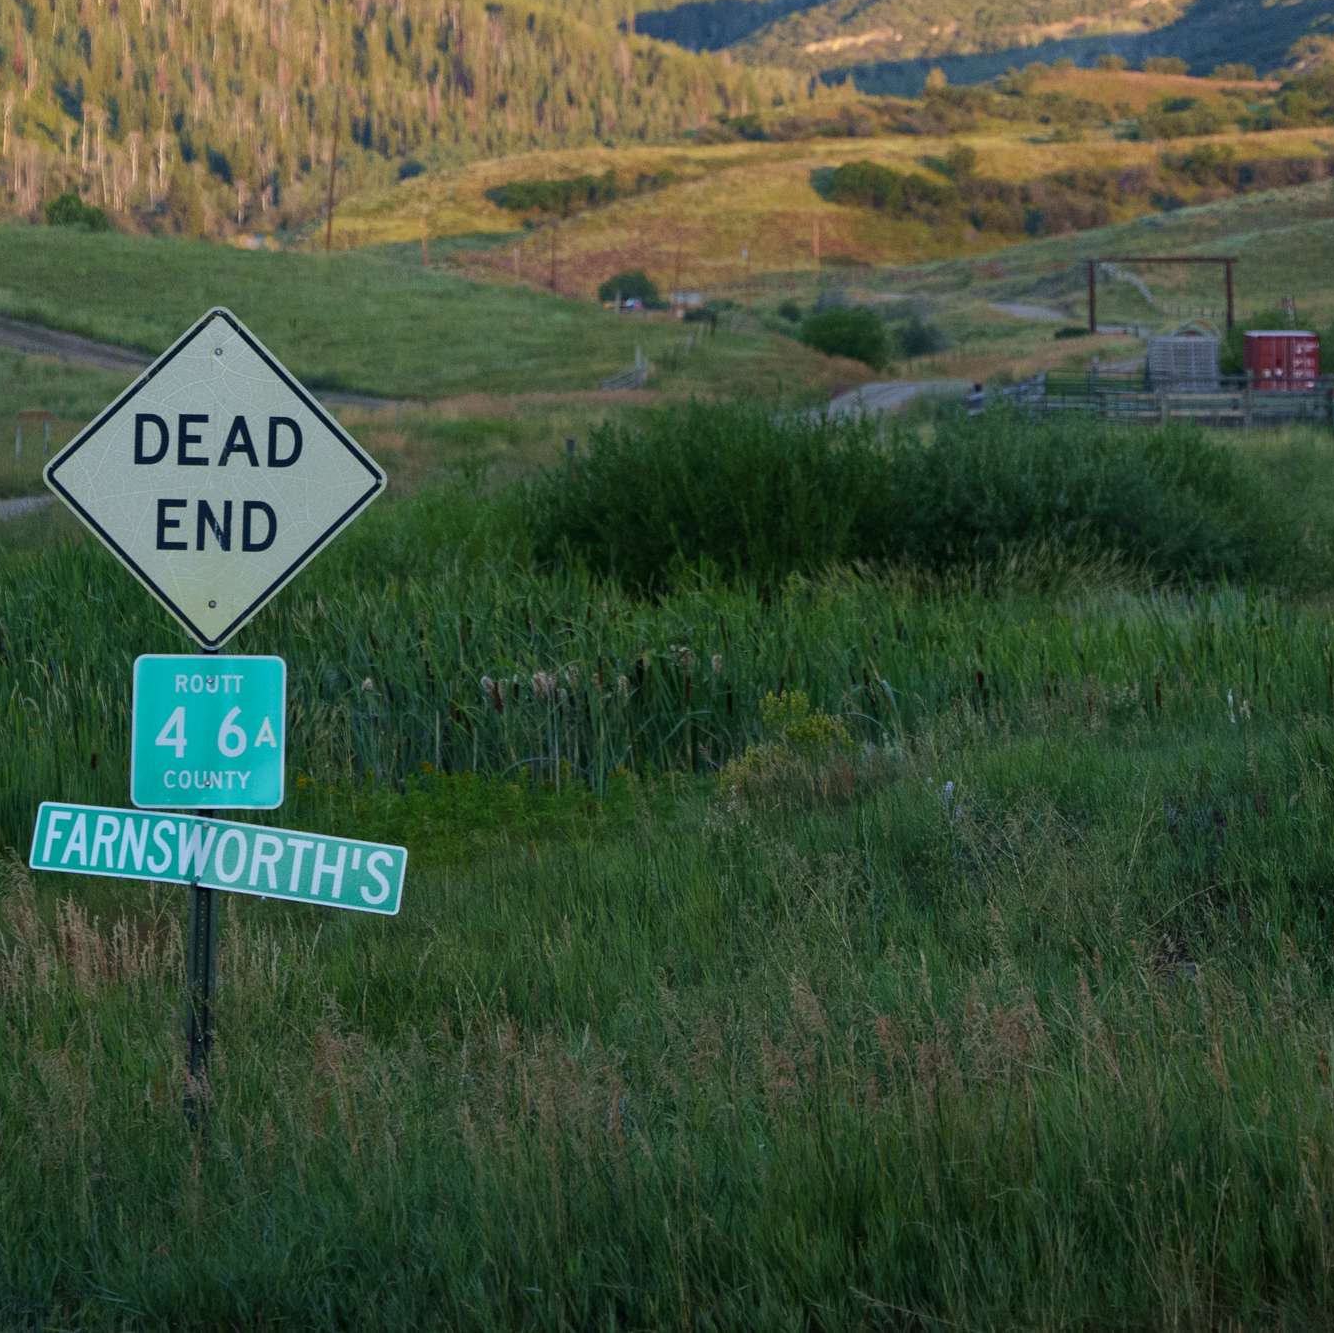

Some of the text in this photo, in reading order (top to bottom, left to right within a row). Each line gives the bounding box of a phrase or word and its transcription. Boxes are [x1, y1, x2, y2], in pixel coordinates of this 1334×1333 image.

[134, 413, 303, 468] DEAD
[156, 498, 278, 553] END
[174, 673, 244, 694] ROUTT
[163, 769, 252, 790] COUNTY
[41, 810, 394, 905] FARNSWORTH'S
